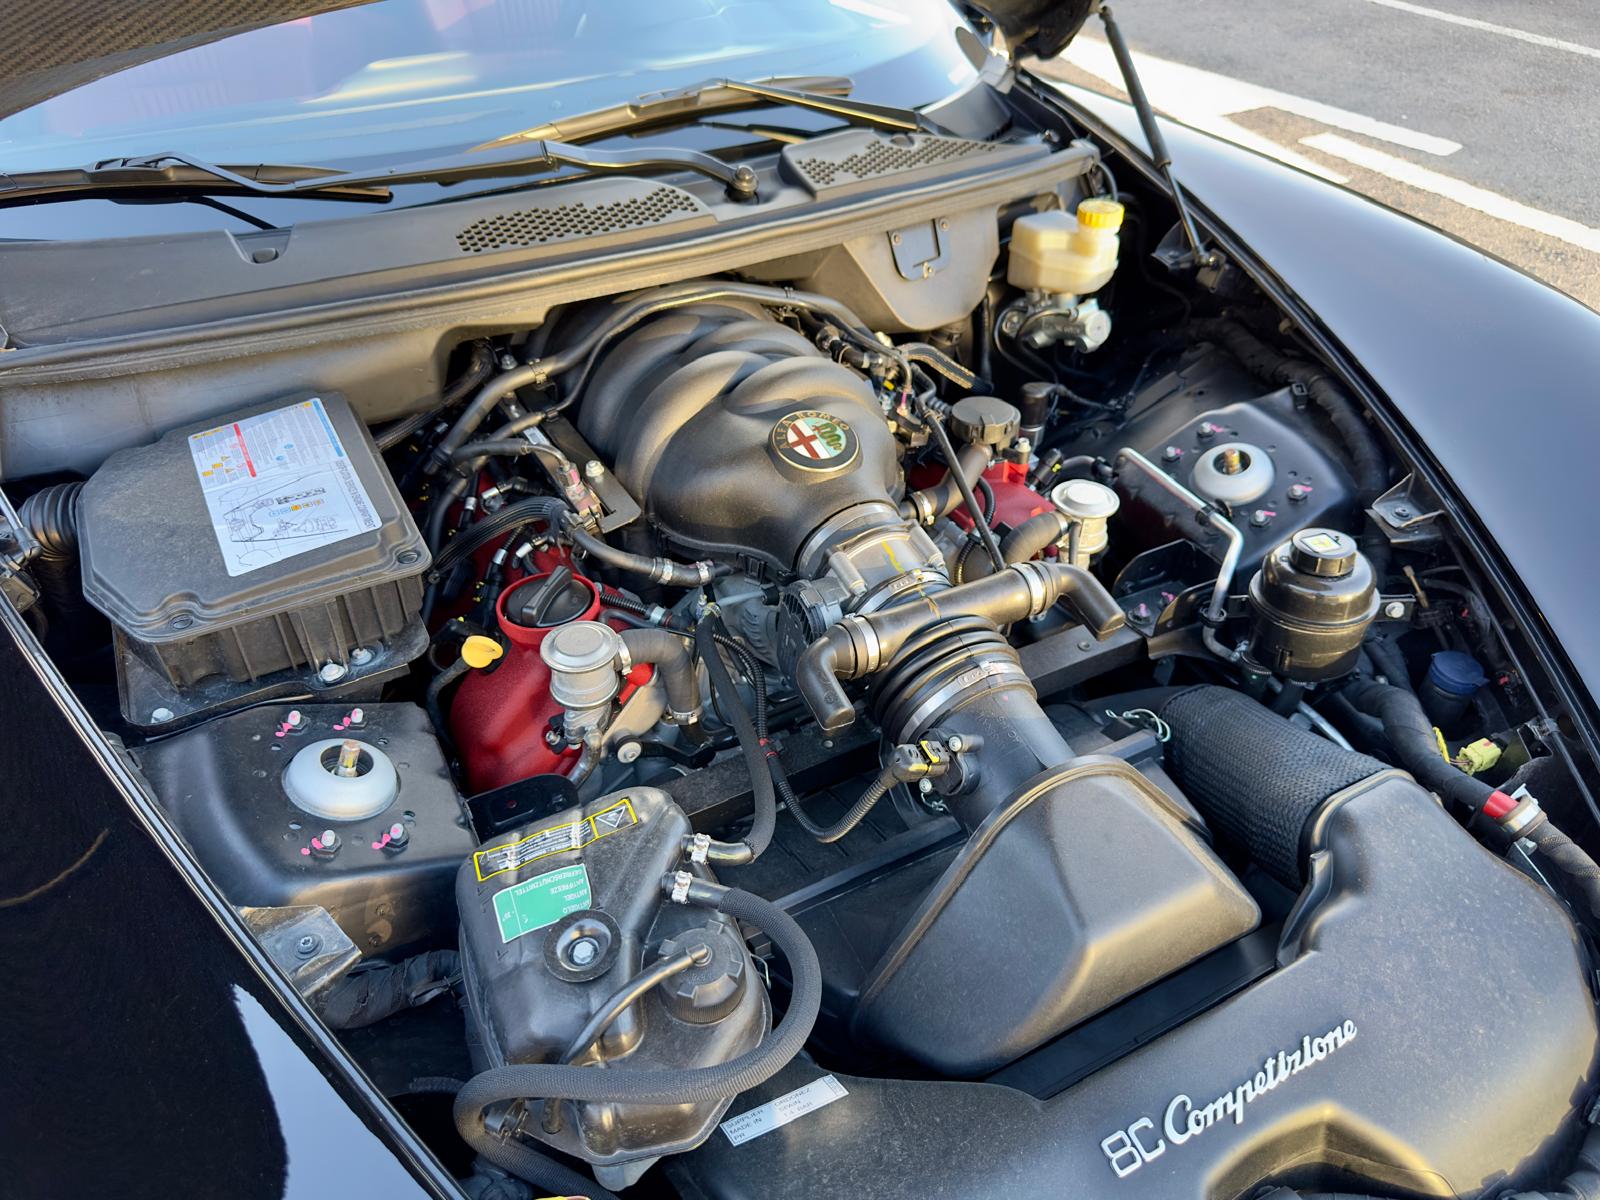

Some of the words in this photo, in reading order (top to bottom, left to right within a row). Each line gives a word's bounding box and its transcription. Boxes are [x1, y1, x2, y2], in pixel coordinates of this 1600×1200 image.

[776, 420, 792, 449] ALFA
[795, 411, 849, 430] ROMEO
[1101, 1116, 1166, 1178] 8C
[1164, 1019, 1357, 1145] Competizione
[727, 1109, 764, 1128] SUPPLIER
[730, 1122, 751, 1134] MADE
[753, 1117, 762, 1125] IN
